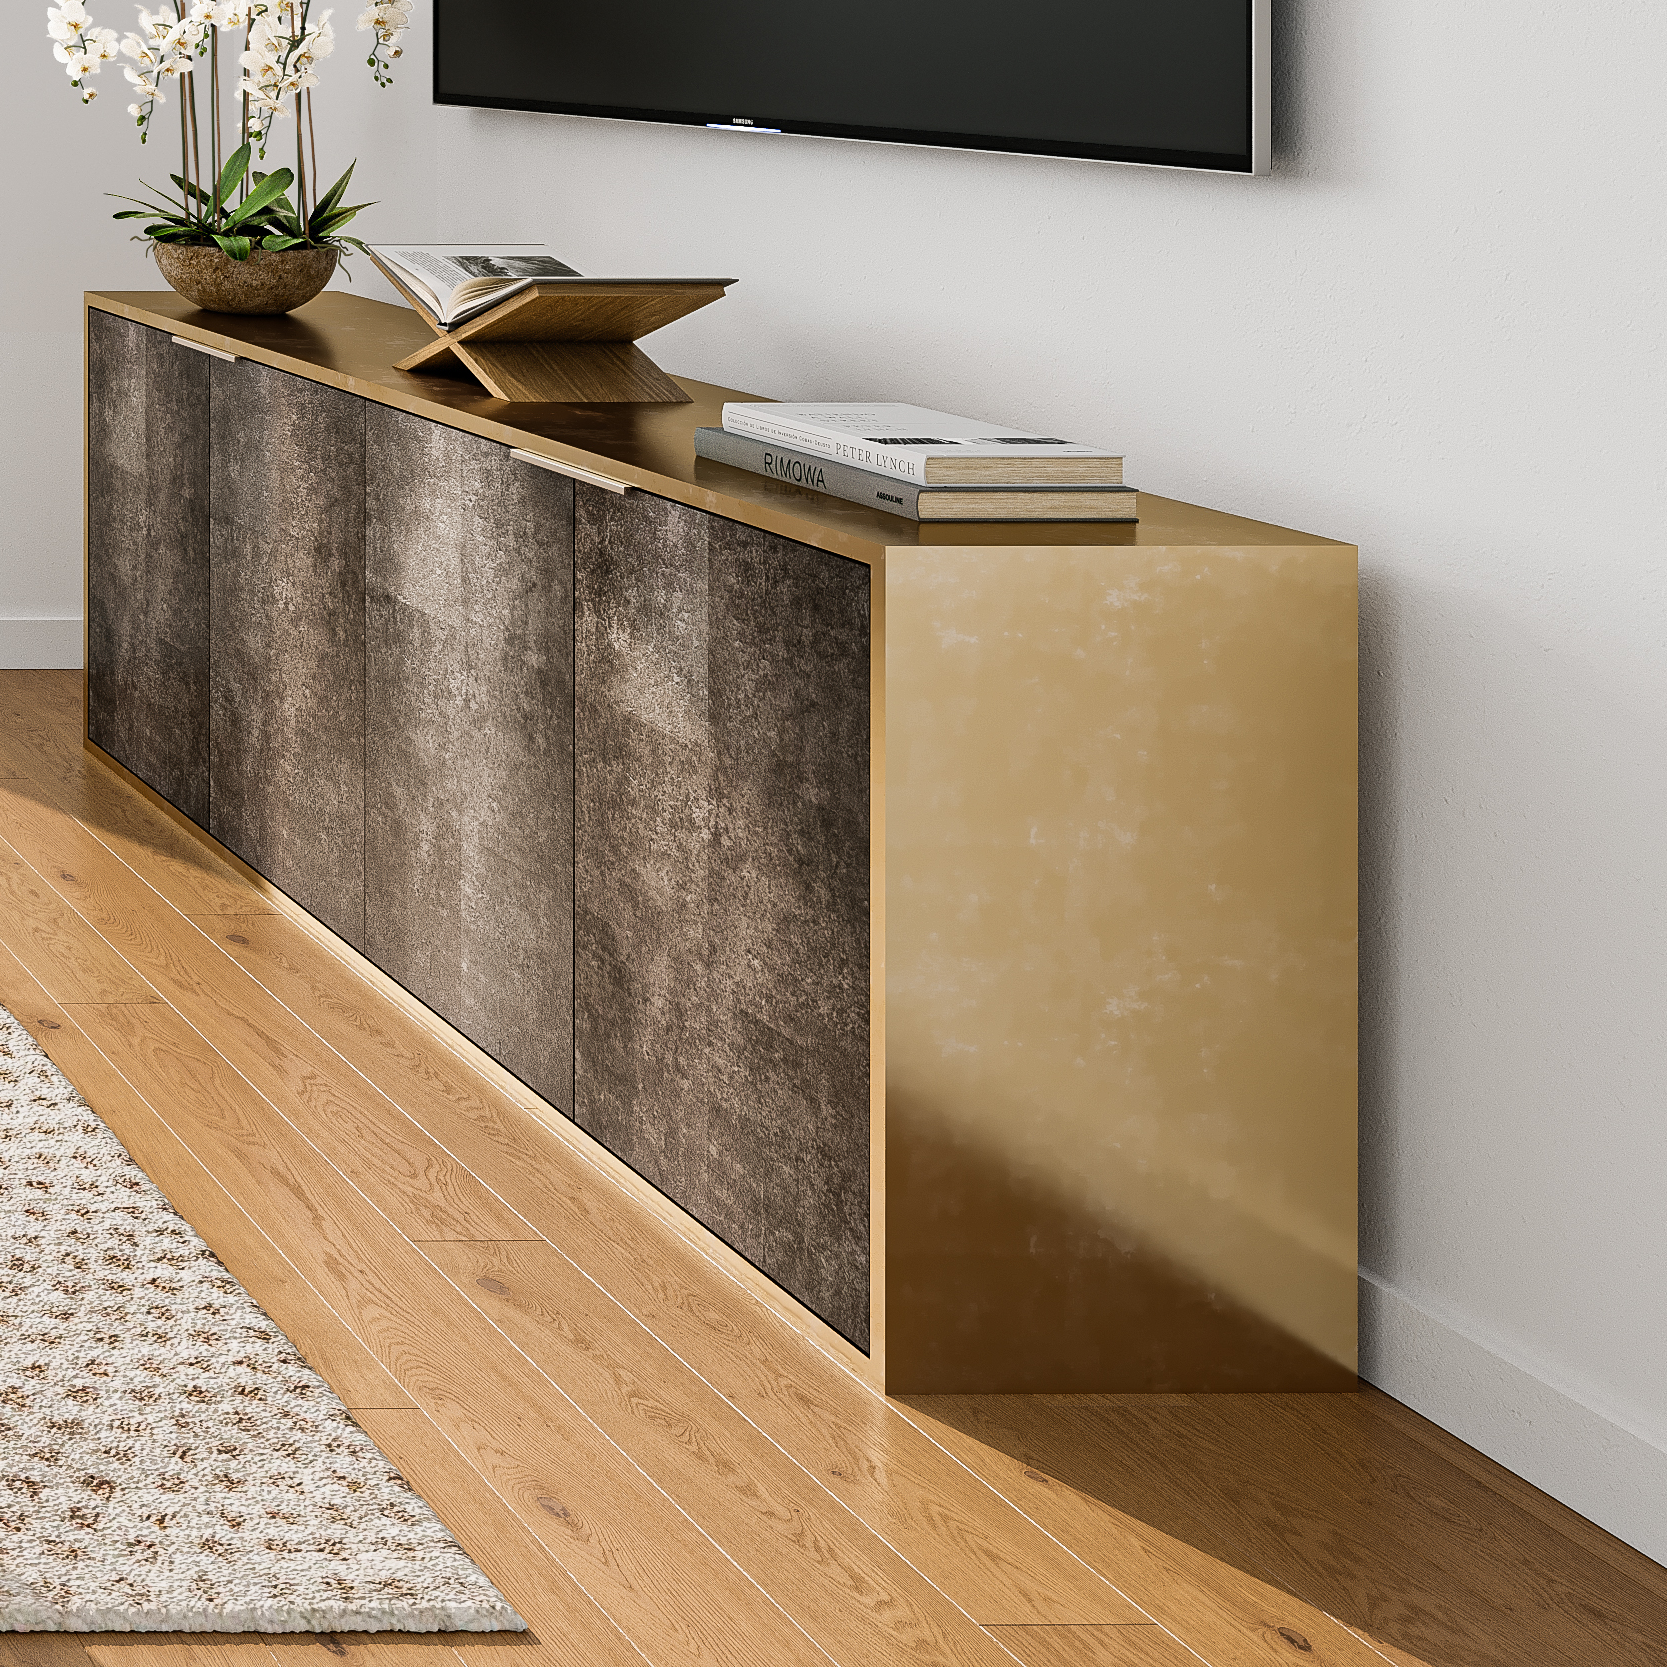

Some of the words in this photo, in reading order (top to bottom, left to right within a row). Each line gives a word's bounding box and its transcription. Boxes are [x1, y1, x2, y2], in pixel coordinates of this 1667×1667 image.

[732, 117, 754, 126] SAMSUNG
[764, 452, 827, 490] RIMOWA
[835, 442, 873, 465] PETER
[876, 453, 916, 476] LYNCH
[876, 491, 904, 505] ASSOULINE
